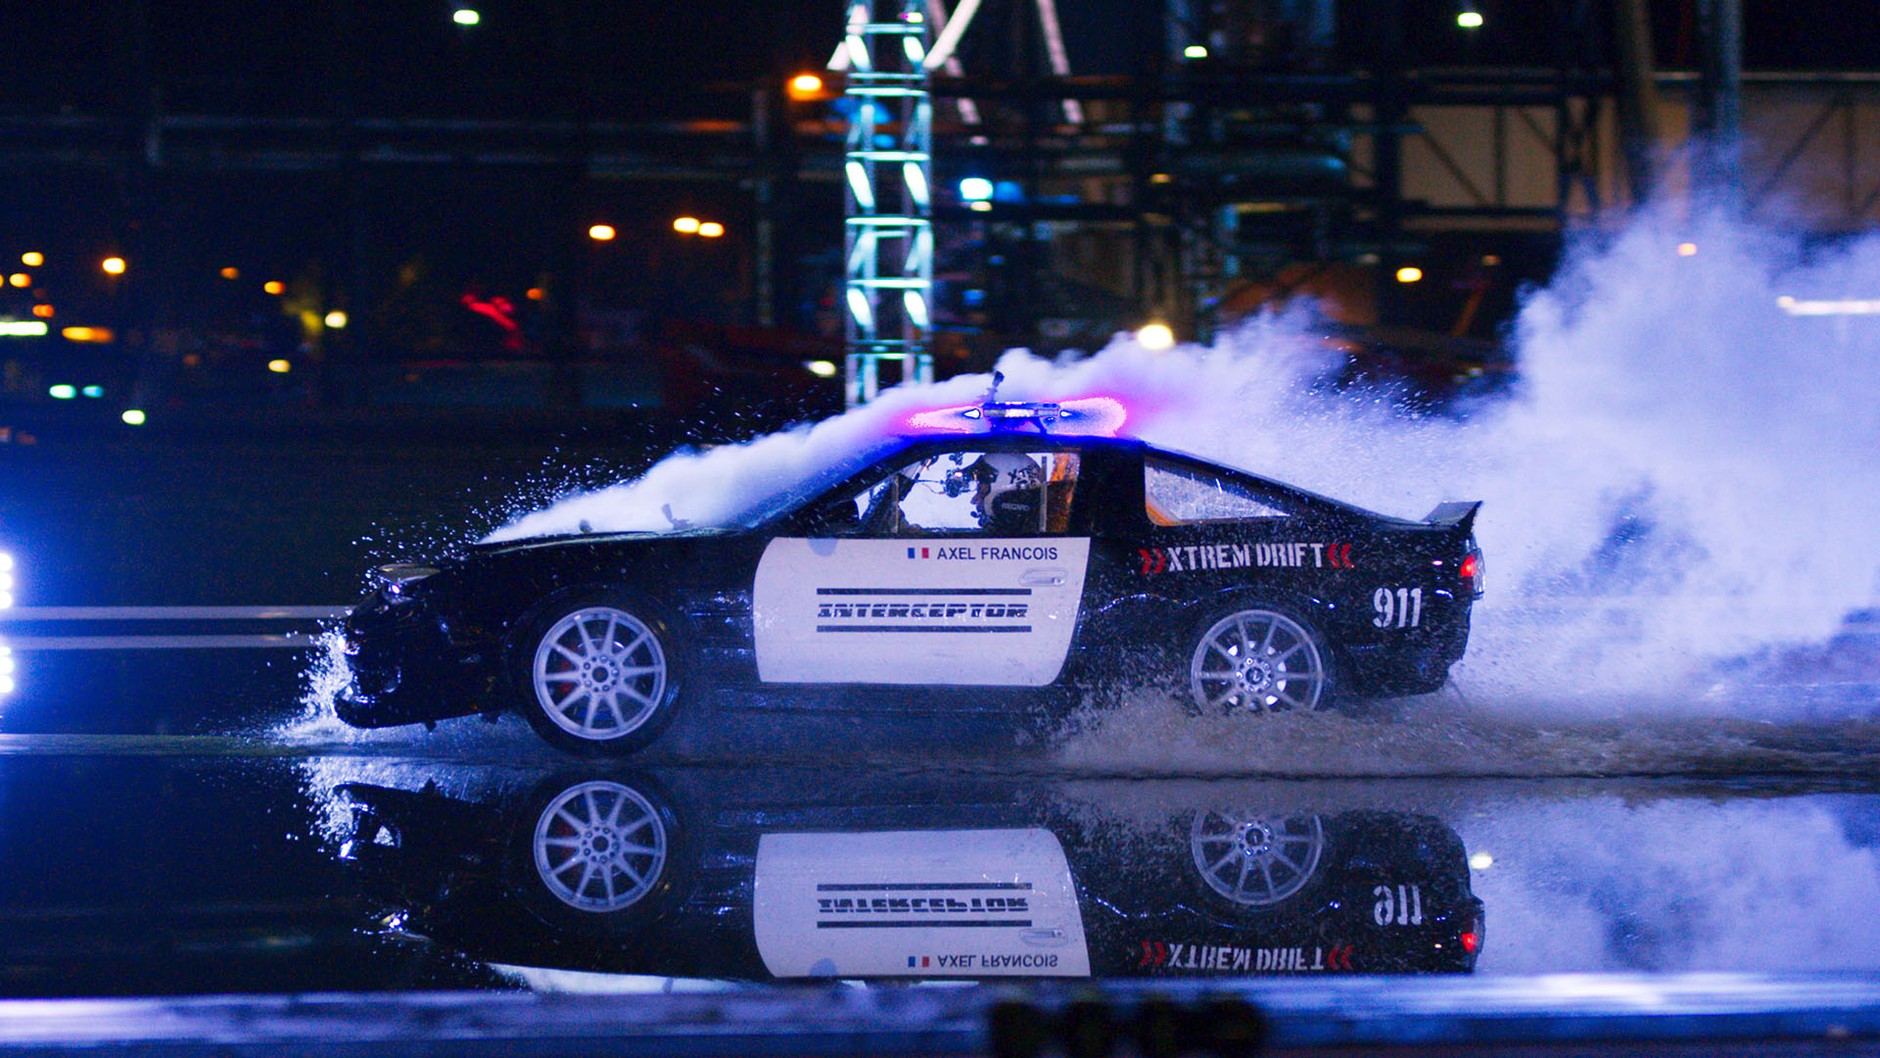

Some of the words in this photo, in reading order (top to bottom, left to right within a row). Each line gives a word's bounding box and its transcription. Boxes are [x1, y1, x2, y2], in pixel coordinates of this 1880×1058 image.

[936, 546, 976, 561] AXEL
[980, 546, 1059, 561] FRANCOIS
[1166, 543, 1251, 572] XTREM
[1255, 542, 1325, 569] DRIFT
[817, 602, 1029, 619] INTERCEPTOR
[1373, 587, 1423, 628] 911
